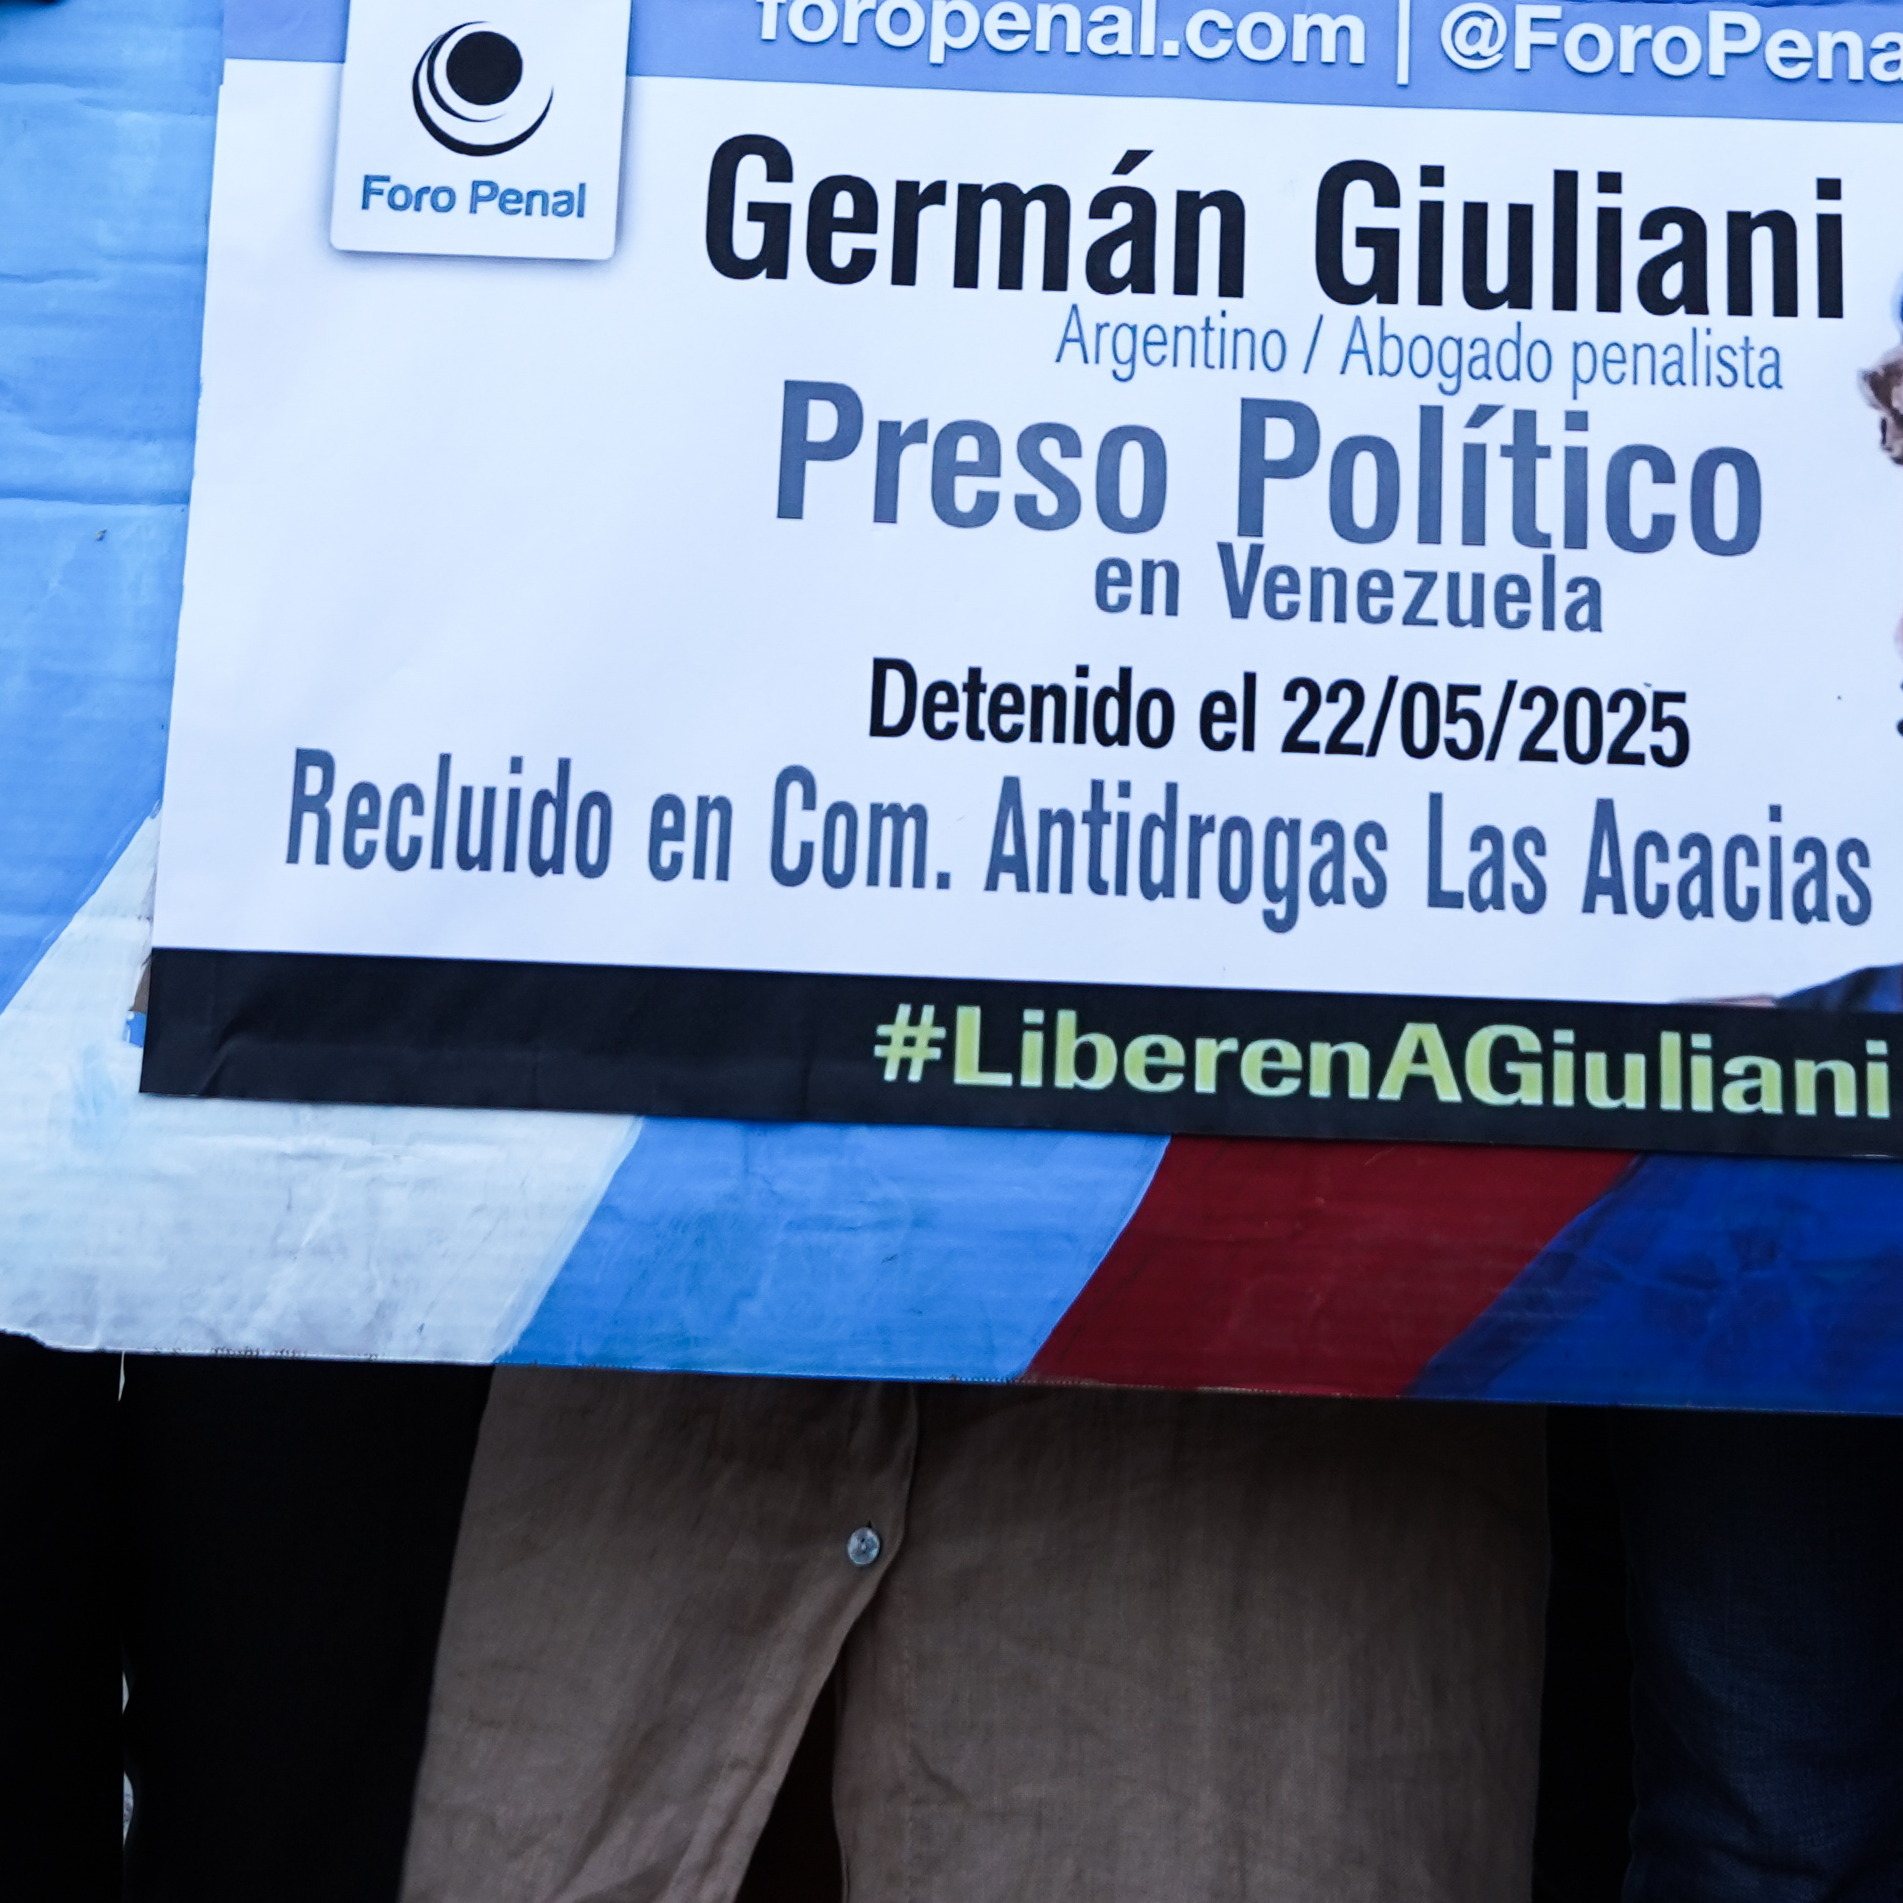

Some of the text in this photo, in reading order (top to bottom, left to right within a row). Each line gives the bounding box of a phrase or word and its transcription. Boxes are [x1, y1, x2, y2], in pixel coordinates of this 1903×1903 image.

[361, 174, 586, 218] Foro Penal
[705, 134, 1844, 319] Germán Giuliani
[1055, 303, 1287, 382] Argentino
[1340, 314, 1552, 395] Abogado
[1571, 328, 1783, 400] penalista
[777, 380, 1762, 556] Preso Político
[1095, 541, 1603, 632] en Venezuela
[869, 657, 1690, 767] Detenido el 22/05/2025
[286, 748, 1873, 934] Recluido en Com. Antidrogas Las Acacias
[873, 1003, 1891, 1121] #LiberenAGiuliani
